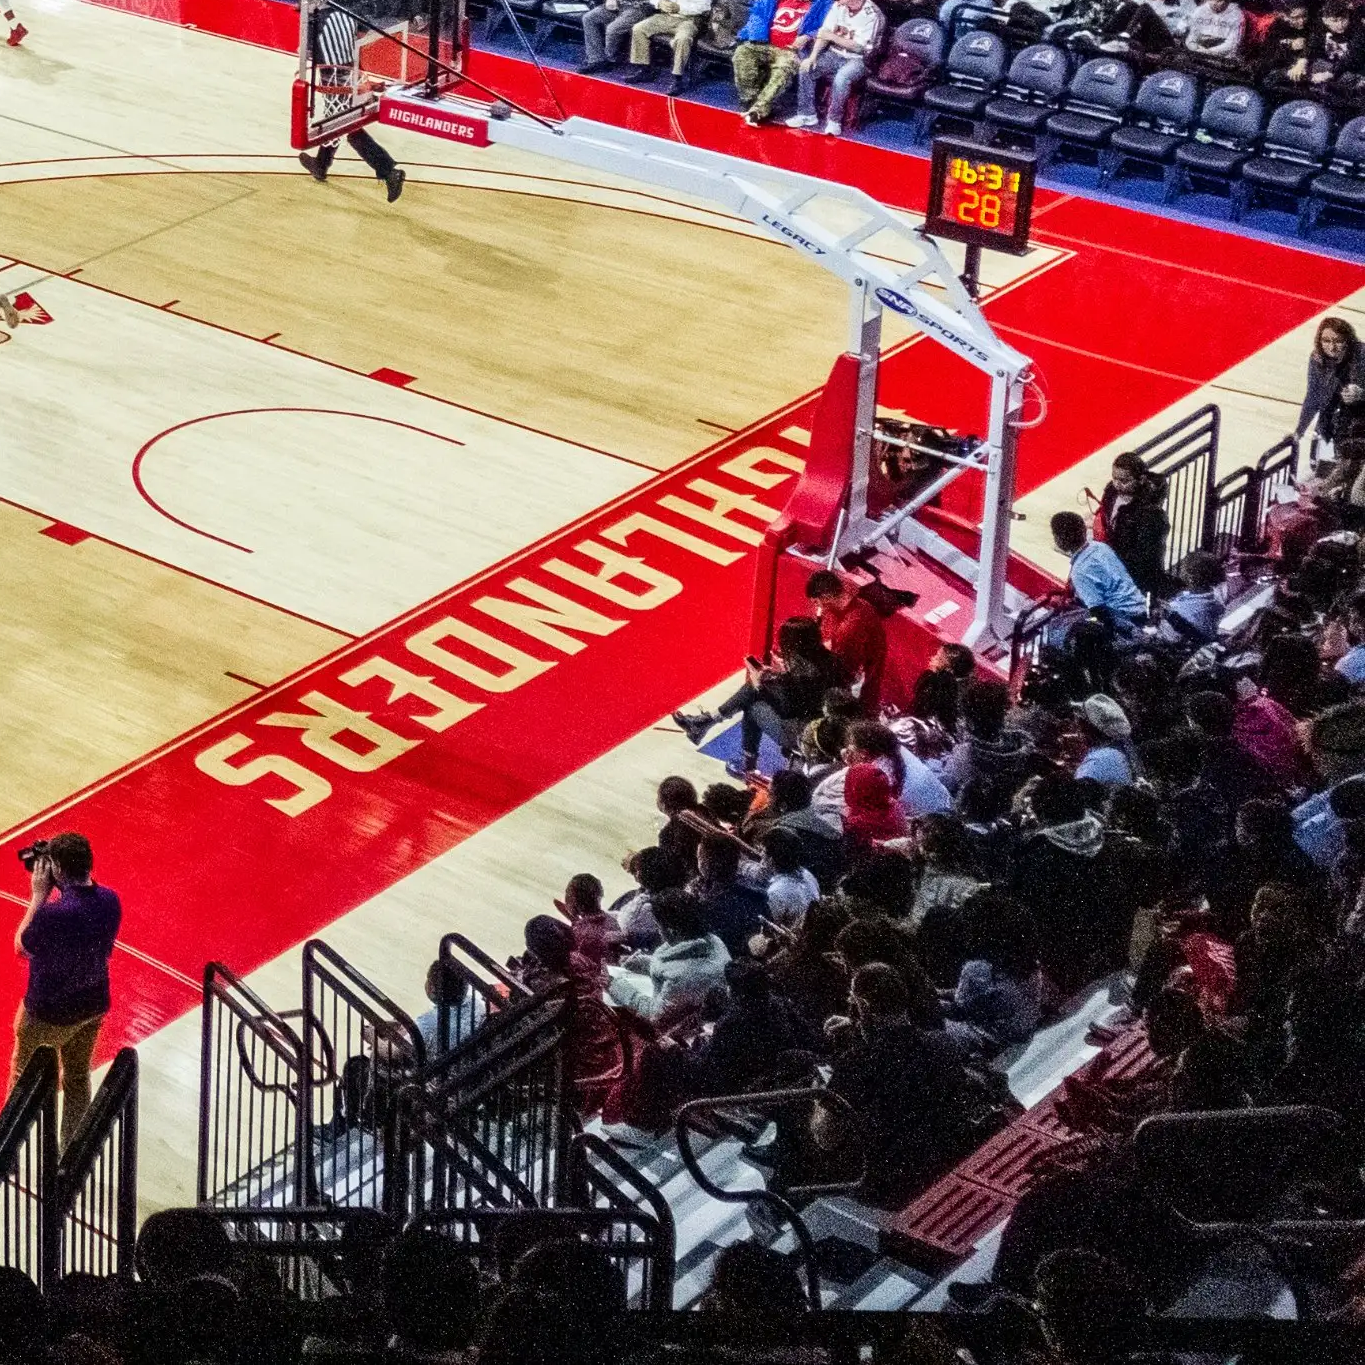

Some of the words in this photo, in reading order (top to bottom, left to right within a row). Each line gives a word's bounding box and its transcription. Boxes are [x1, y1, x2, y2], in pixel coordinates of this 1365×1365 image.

[388, 106, 475, 139] HIGHLANDERS
[950, 157, 1021, 193] 16:31
[957, 188, 1002, 228] 28
[762, 214, 826, 255] LEGACY
[917, 313, 990, 362] SPORTS
